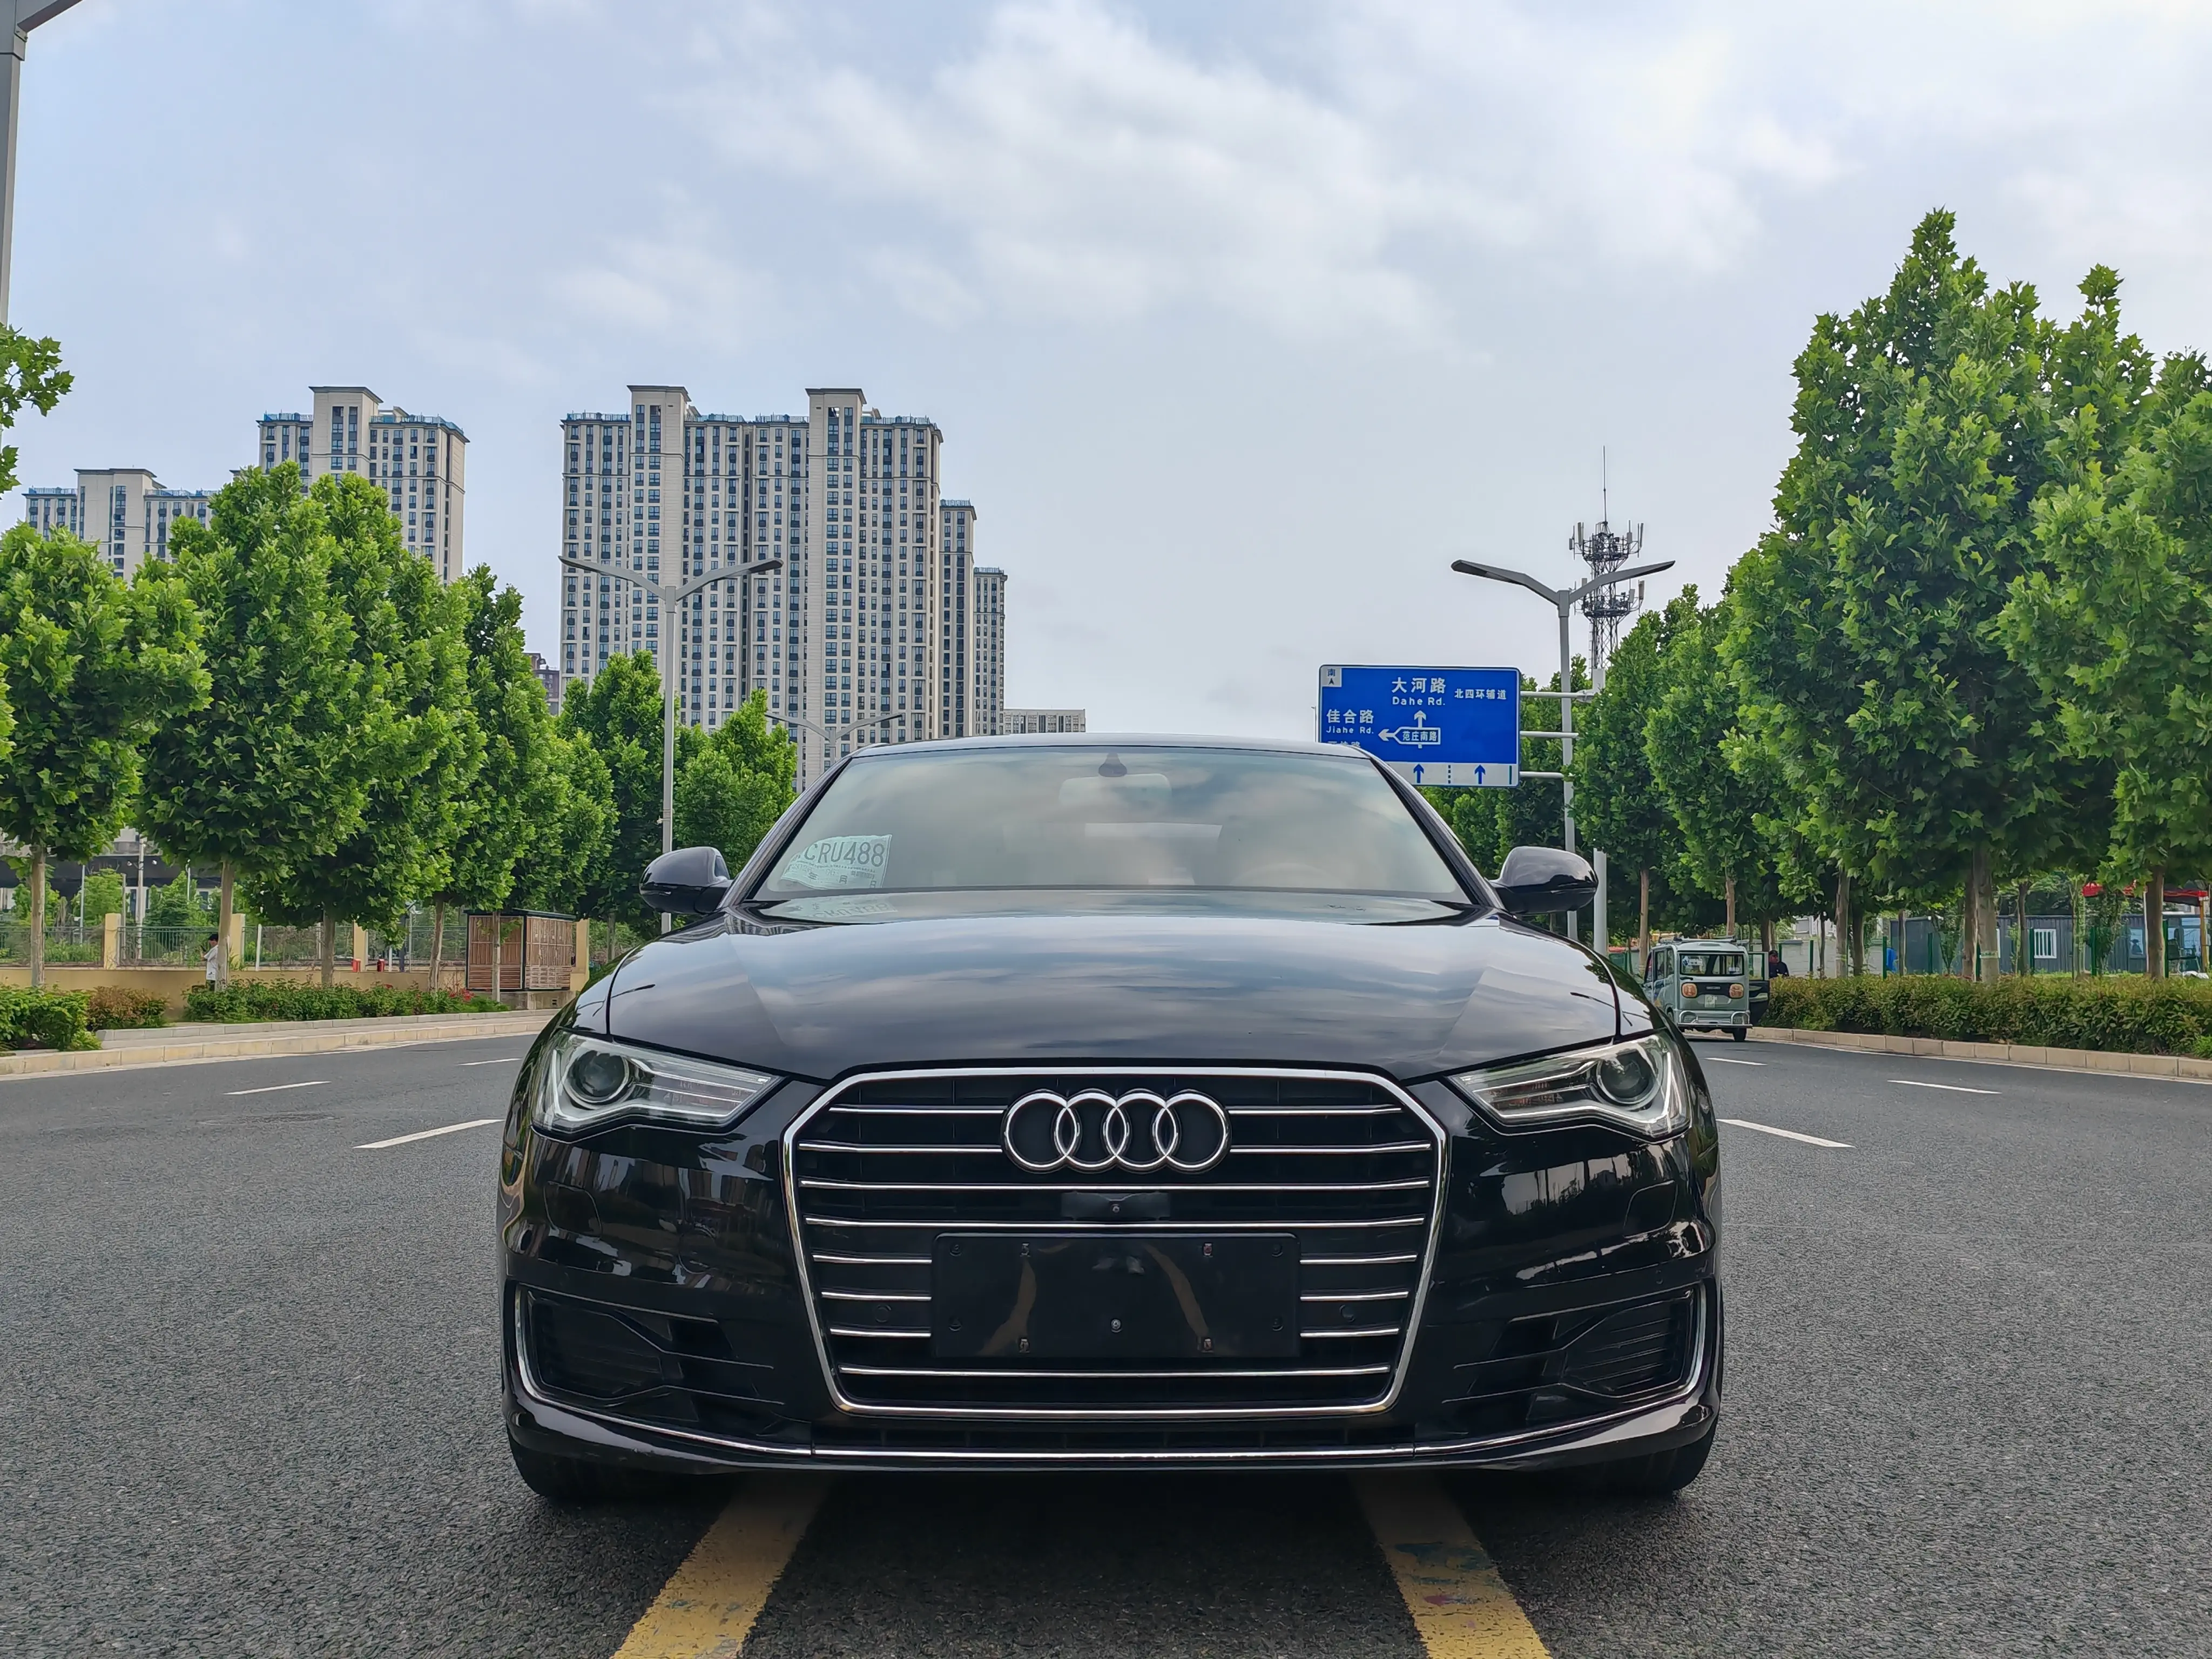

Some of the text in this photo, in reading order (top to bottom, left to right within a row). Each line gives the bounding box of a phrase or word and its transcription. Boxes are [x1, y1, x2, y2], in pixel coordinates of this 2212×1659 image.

[1327, 668, 1336, 677] 南
[1392, 677, 1446, 694] 大河路
[1454, 688, 1507, 700] 北四环辅道
[1392, 696, 1446, 706] Dahe Rd.
[1326, 709, 1374, 724] 佳合路
[1326, 726, 1374, 734] Jiahe Rd.
[1402, 731, 1438, 742] 范庄南路
